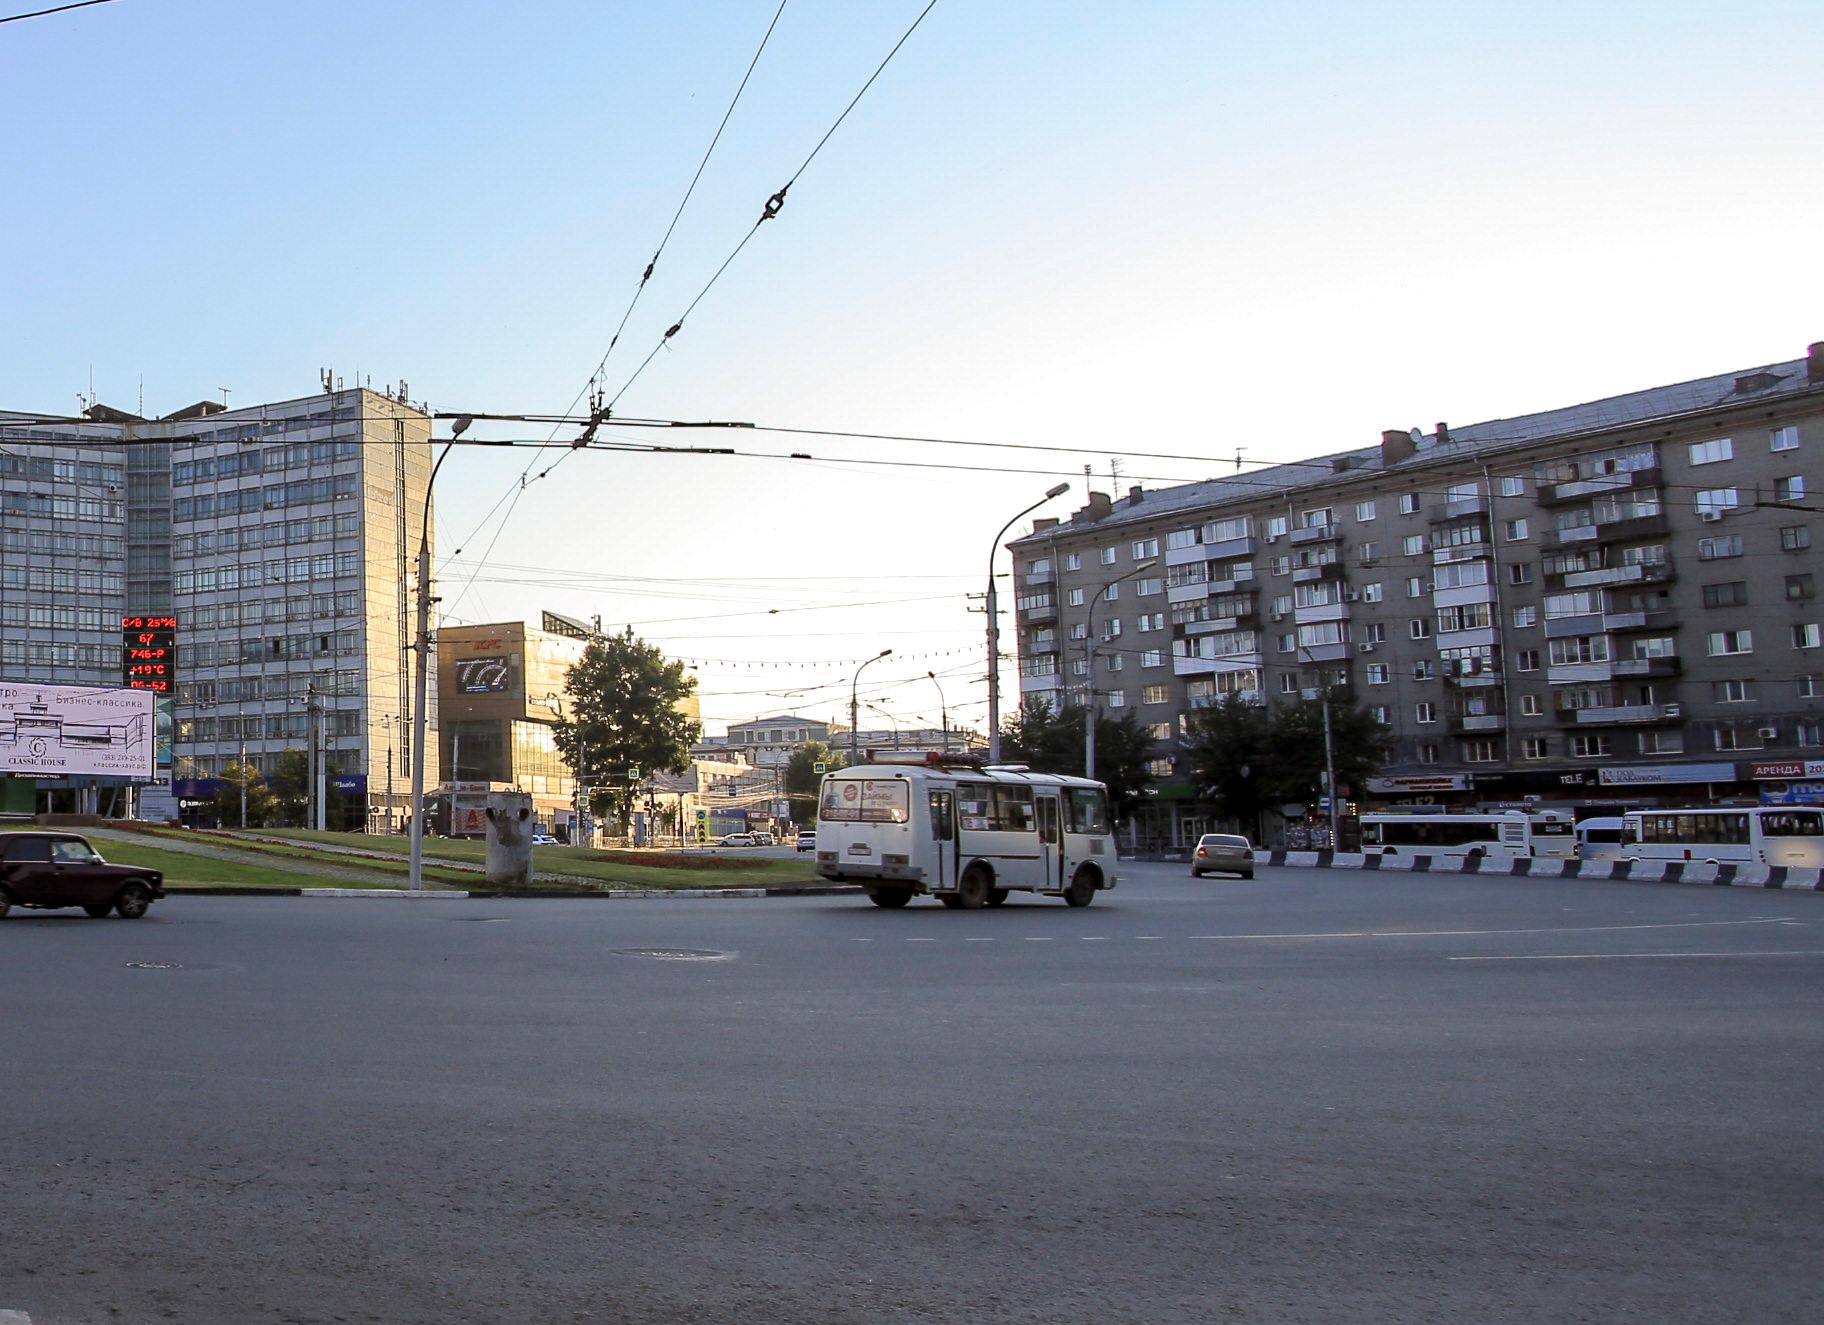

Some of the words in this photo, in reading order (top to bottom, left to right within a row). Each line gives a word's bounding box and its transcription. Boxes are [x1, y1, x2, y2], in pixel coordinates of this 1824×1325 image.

[139, 633, 154, 643] 67
[8, 757, 40, 766] CLASSIC
[41, 758, 67, 767] HOUSE
[1755, 766, 1802, 775] АРЕНДА
